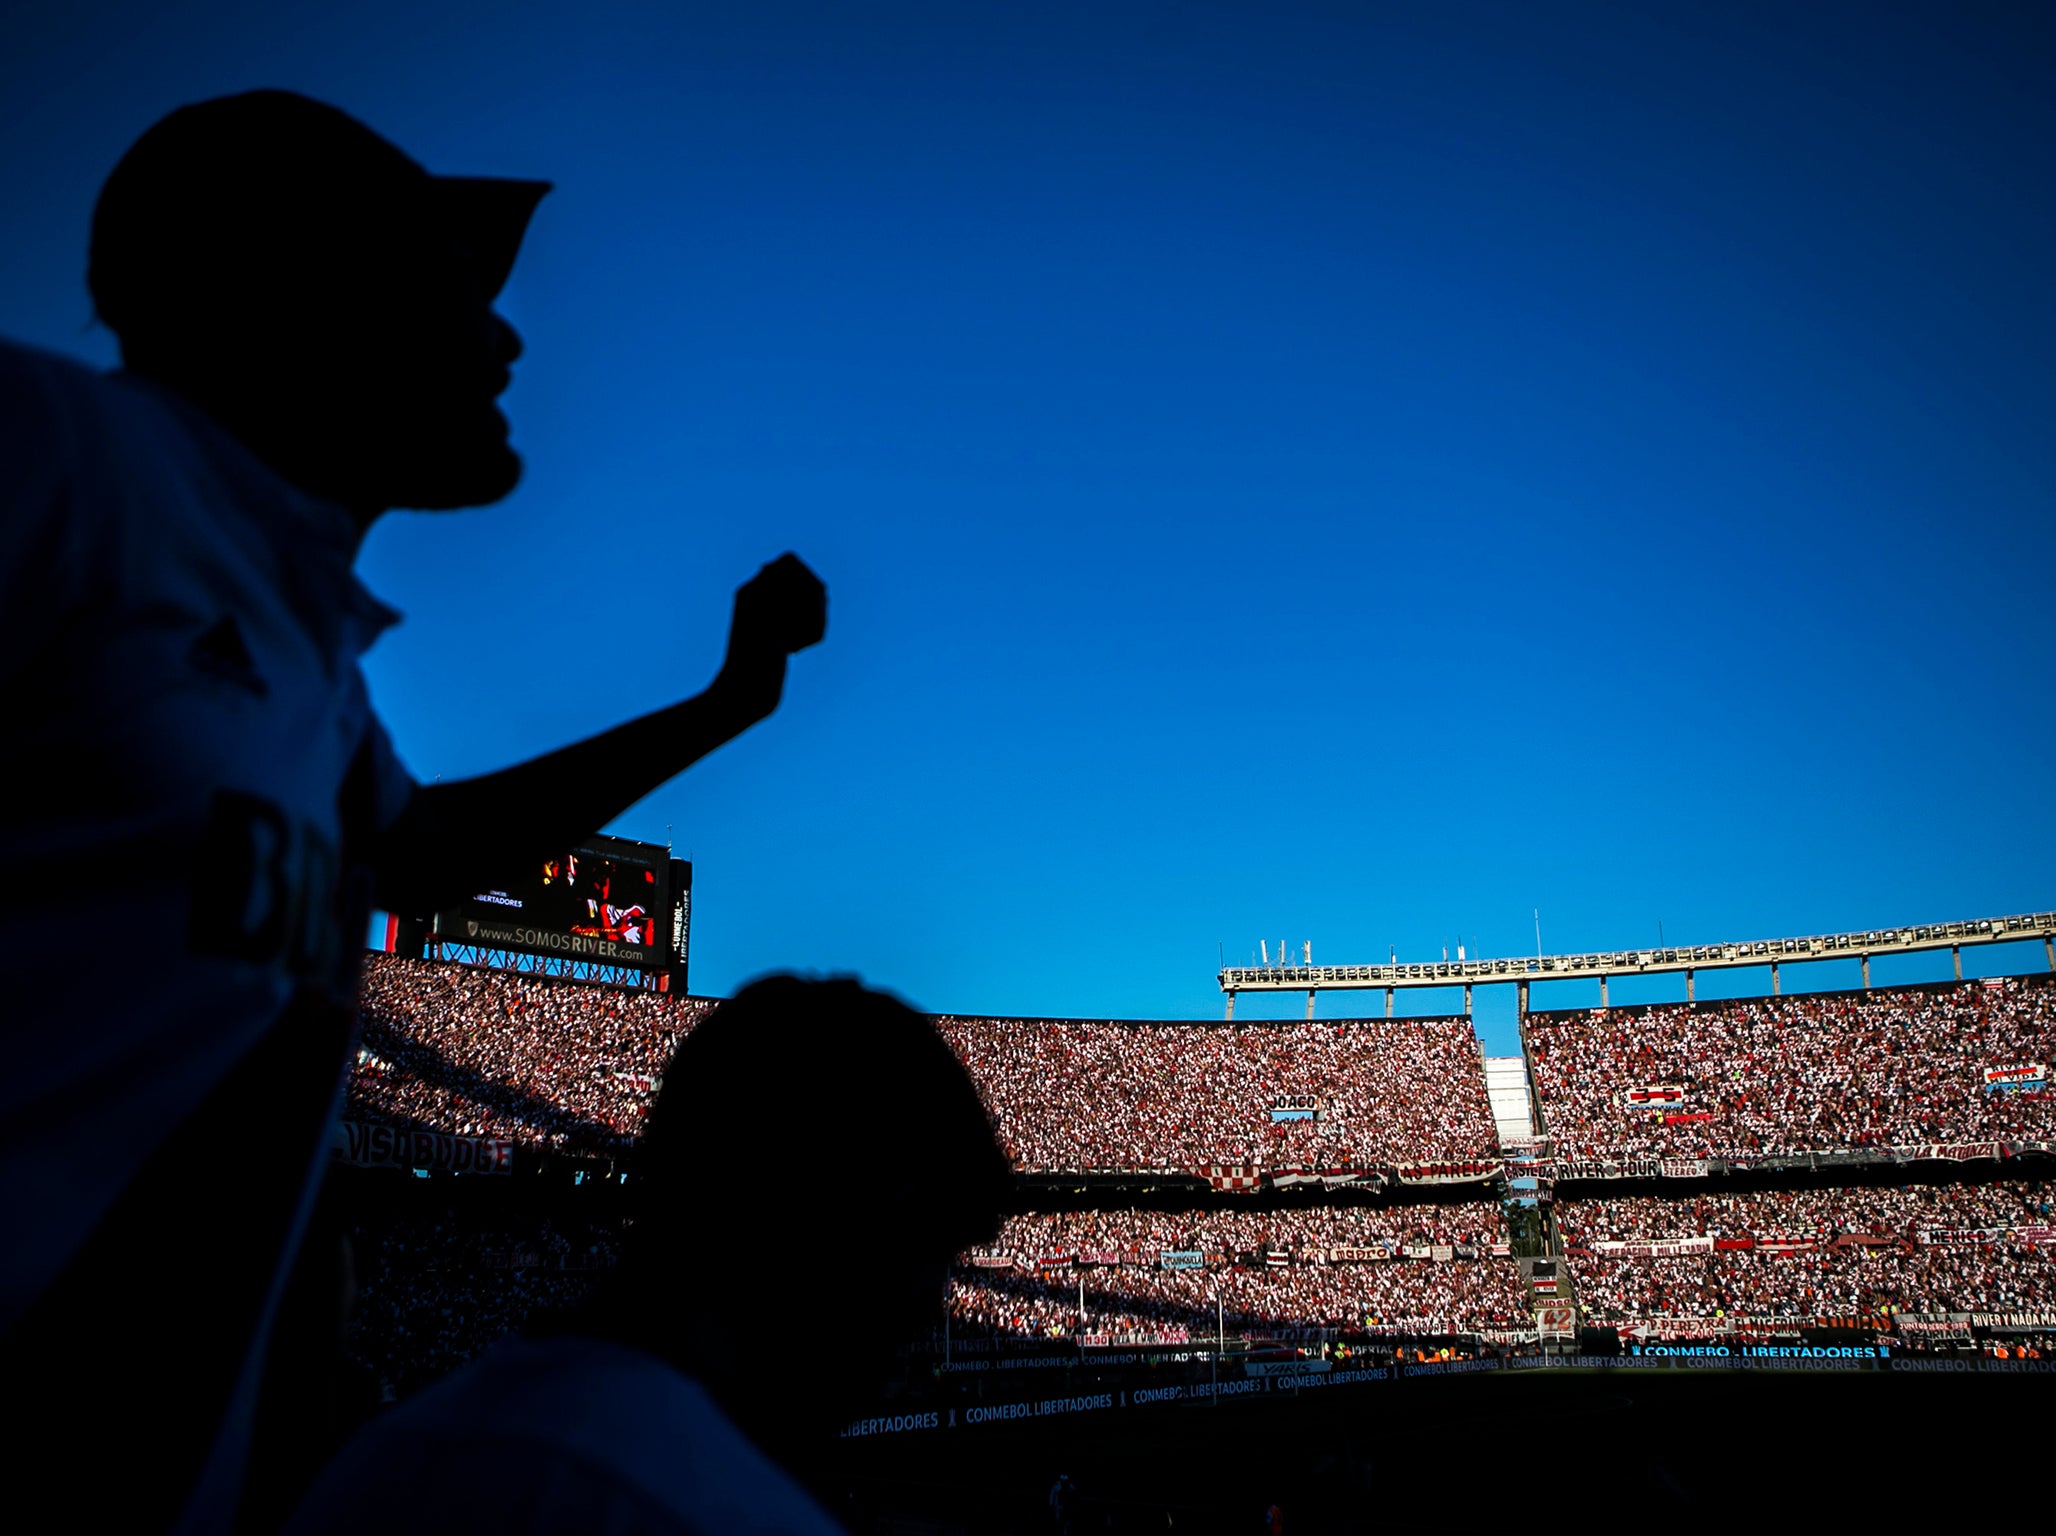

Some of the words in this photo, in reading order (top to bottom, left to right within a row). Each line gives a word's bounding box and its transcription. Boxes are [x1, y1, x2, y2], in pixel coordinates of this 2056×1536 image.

[1560, 1163, 1605, 1179] RIVER
[1619, 1160, 1656, 1177] TOUR
[1973, 1314, 2001, 1327] RIVER
[2010, 1314, 2038, 1326] NADA
[1403, 1364, 1445, 1378] CONMEBOL
[1447, 1359, 1499, 1373] LIBERTADORES
[1571, 1356, 1658, 1368] LIBERTADORES
[1687, 1358, 1759, 1370] CONMEBOL
[1761, 1358, 1861, 1371] LIBERTADORES
[1891, 1359, 1975, 1372] CONMEBOL
[1328, 1368, 1388, 1385] LIBERTADORES
[966, 1401, 1032, 1424] CONMEBOL
[1034, 1393, 1113, 1417] LIBERTADORES
